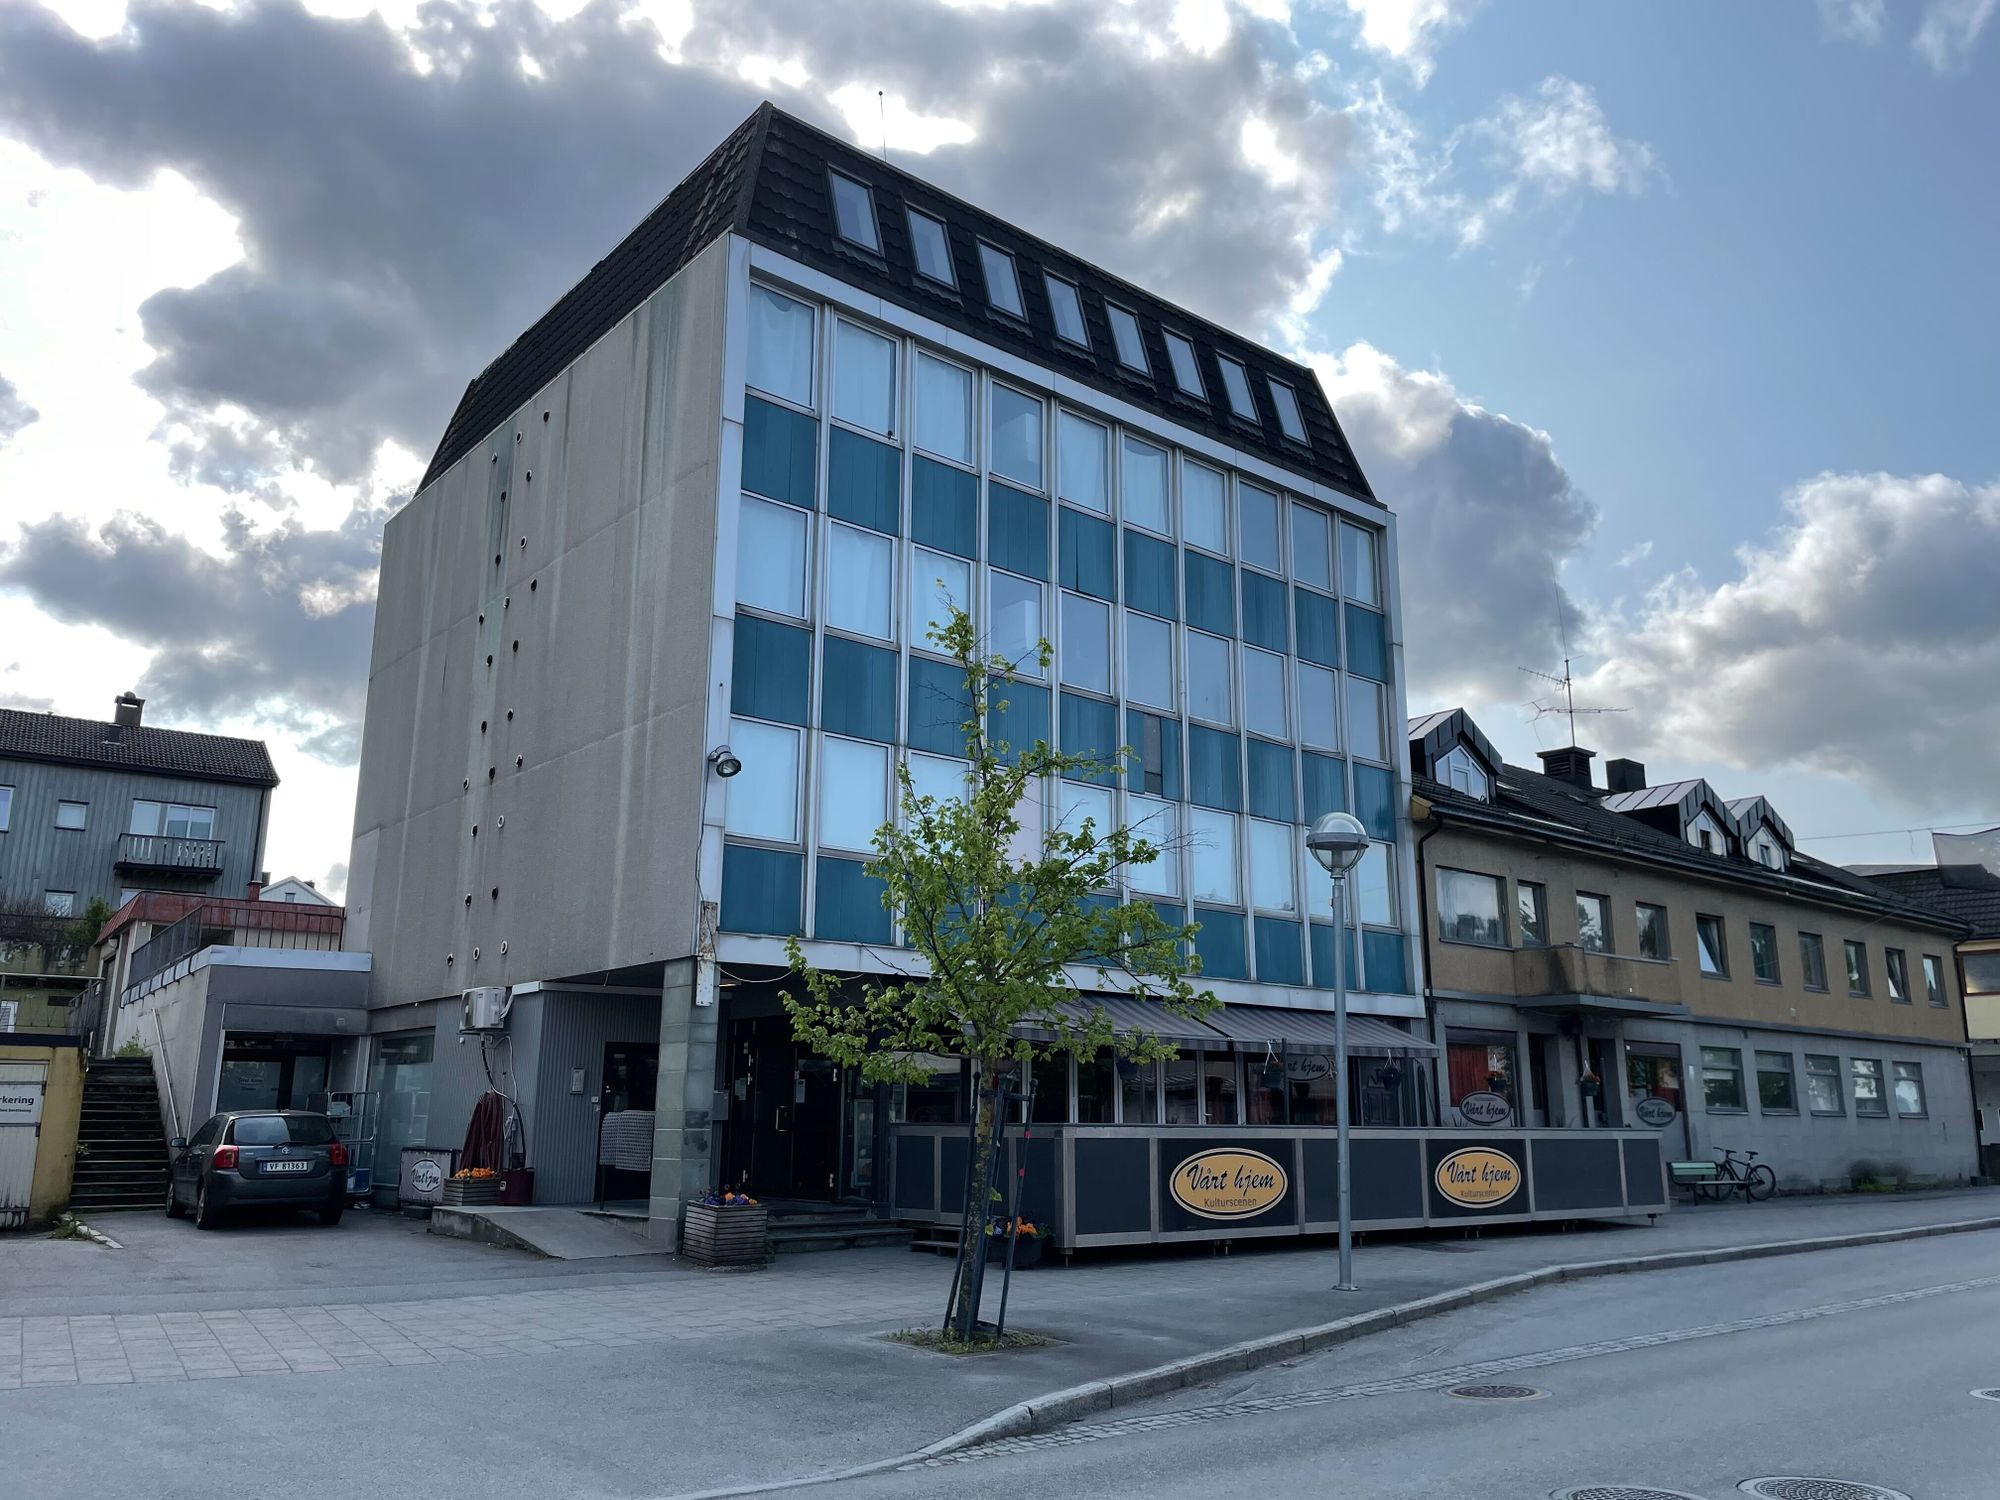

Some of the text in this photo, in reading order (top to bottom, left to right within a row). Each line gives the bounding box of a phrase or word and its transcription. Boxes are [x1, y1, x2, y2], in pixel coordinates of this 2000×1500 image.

[269, 1162, 305, 1171] VF 81363
[1446, 1160, 1512, 1188] Vårt hjem
[1186, 1163, 1275, 1196] Vårt hjem
[1203, 1198, 1257, 1208] Kulturscenen
